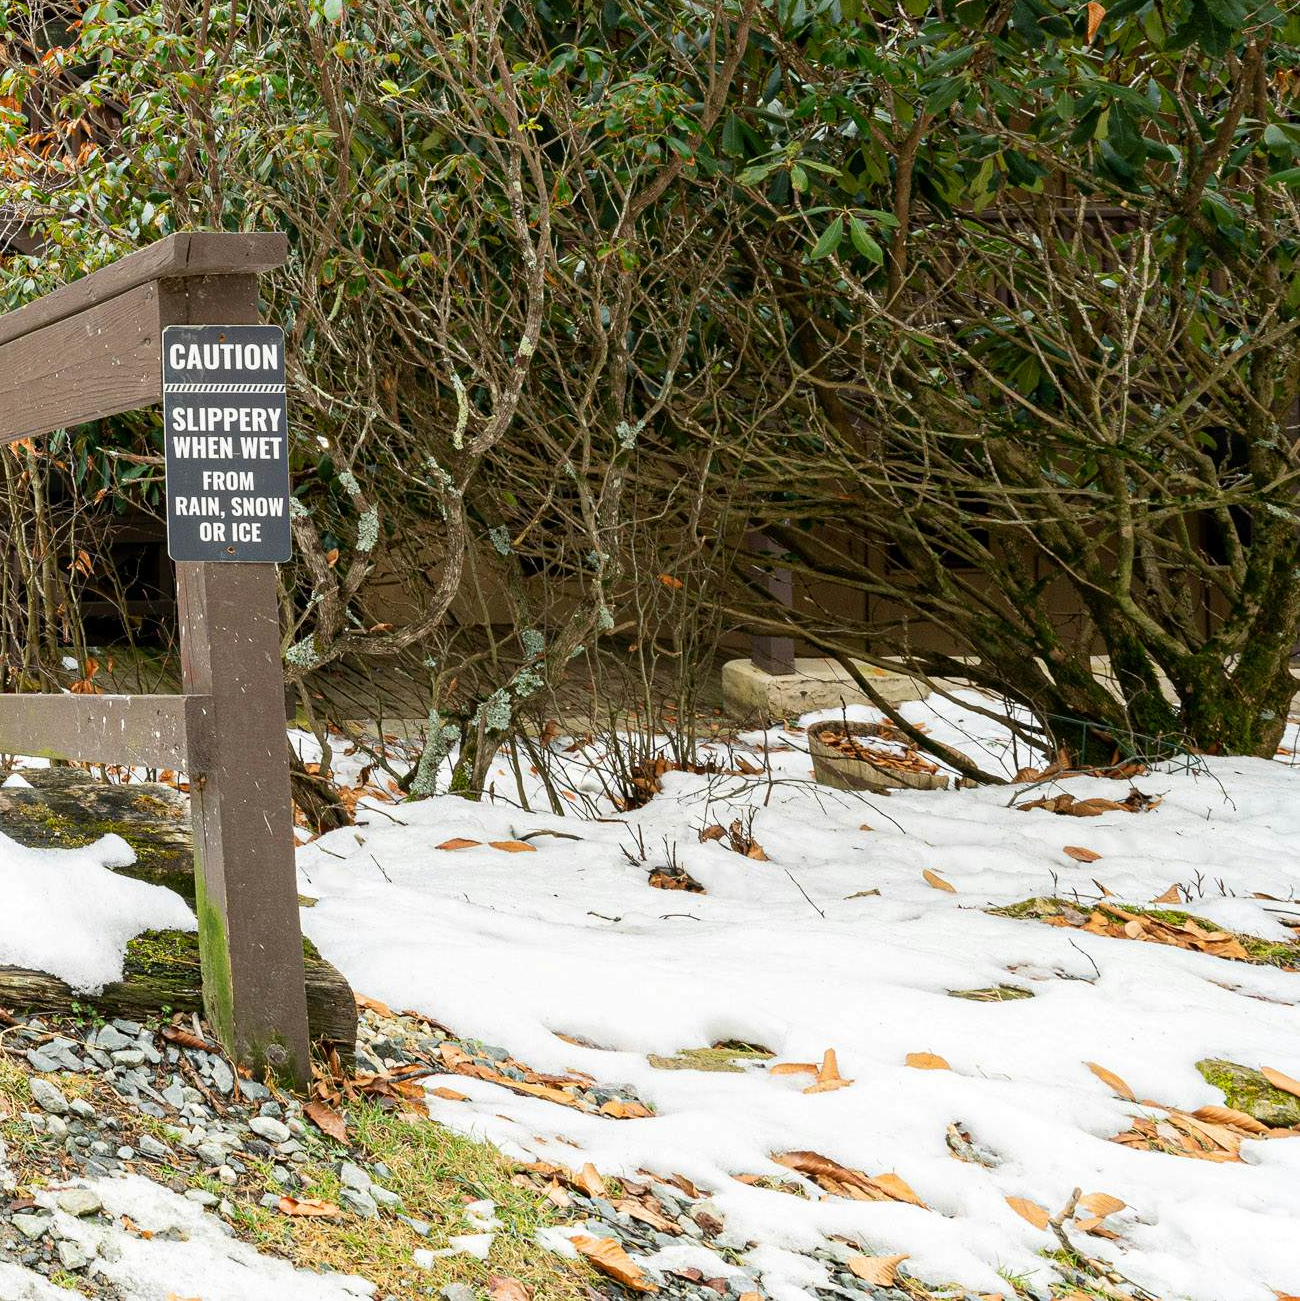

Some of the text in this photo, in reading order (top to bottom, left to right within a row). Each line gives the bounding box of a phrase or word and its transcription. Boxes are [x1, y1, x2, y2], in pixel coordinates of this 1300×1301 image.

[169, 344, 278, 370] CAUTION
[172, 407, 282, 432] SLIPPERY
[173, 436, 282, 459] WHEN WET
[203, 471, 254, 491] FROM
[175, 496, 283, 519] RAIN, SNOW
[200, 522, 261, 543] OR ICE
